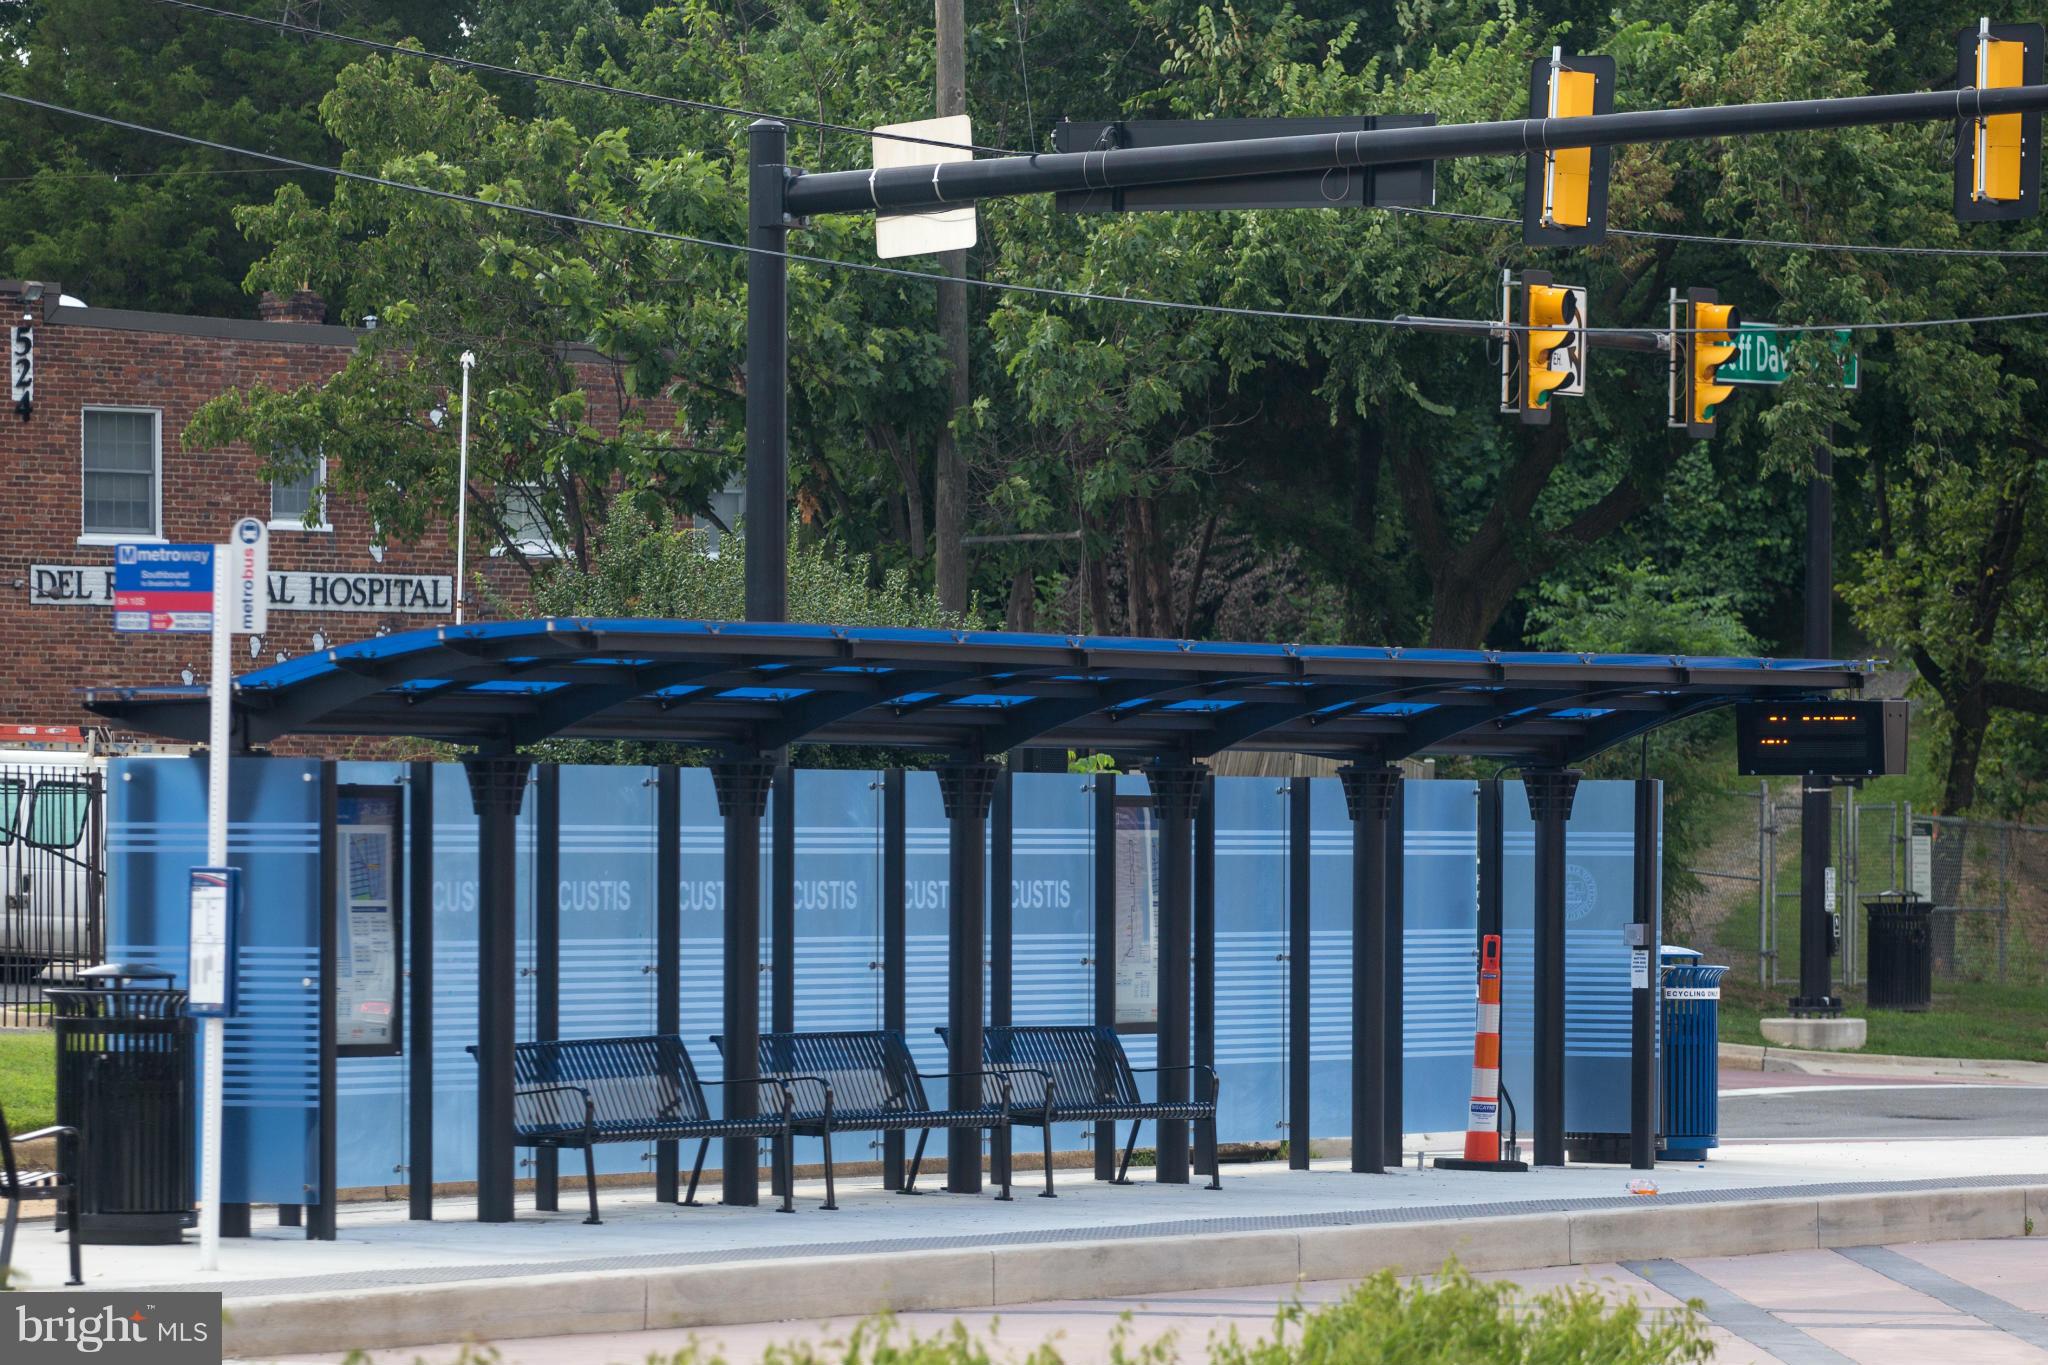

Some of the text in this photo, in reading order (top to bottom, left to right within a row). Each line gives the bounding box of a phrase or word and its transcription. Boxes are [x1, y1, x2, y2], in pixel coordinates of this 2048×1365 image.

[138, 547, 209, 564] metroway
[35, 569, 93, 601] DEL
[309, 576, 448, 608] HOSPITAL
[241, 547, 255, 630] metrobus
[558, 880, 631, 911] CUSTIS
[793, 880, 857, 910] CUSTIS
[1011, 879, 1071, 909] CUSTIS
